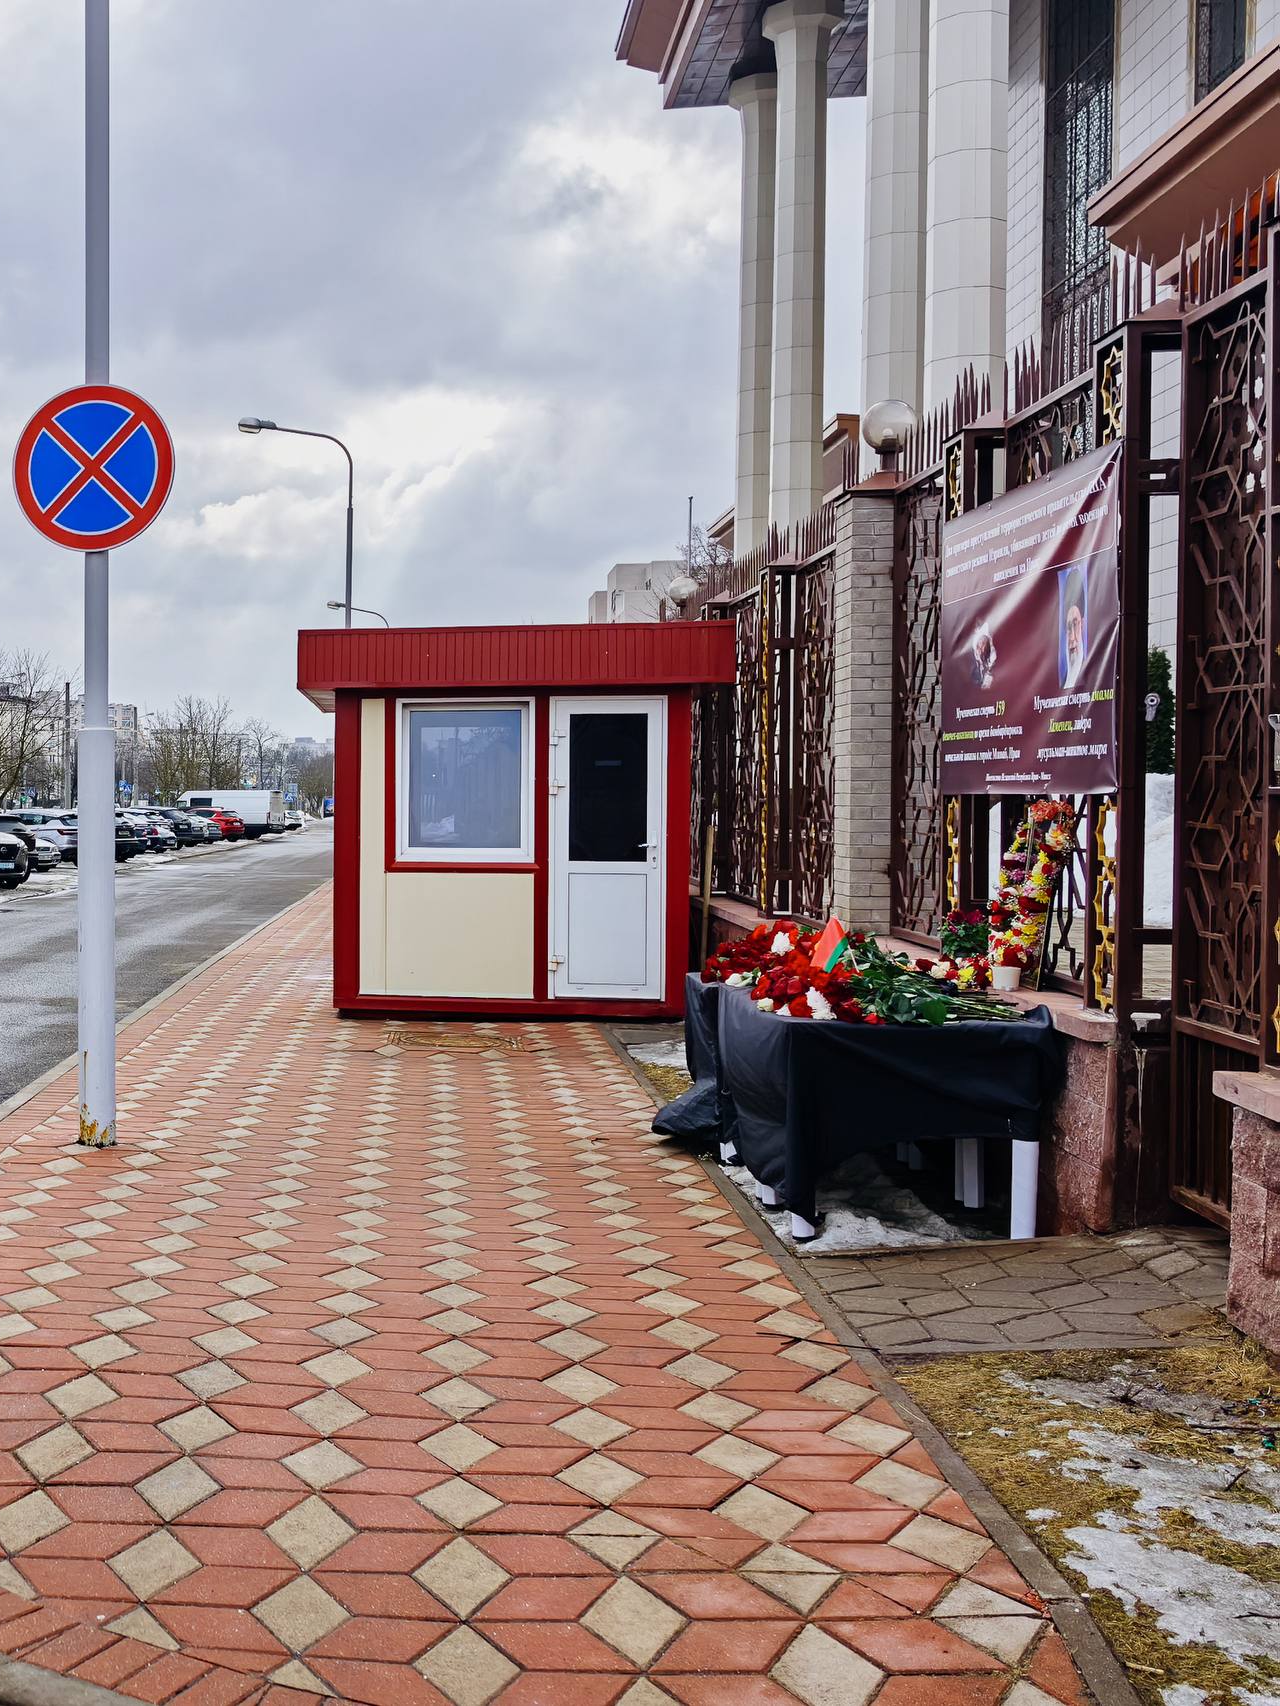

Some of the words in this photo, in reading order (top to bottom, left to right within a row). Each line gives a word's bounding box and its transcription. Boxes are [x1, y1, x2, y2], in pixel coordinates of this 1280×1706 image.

[996, 700, 1006, 716] 159
[1034, 694, 1068, 713] Мученическая
[1069, 692, 1090, 708] смерть
[1091, 689, 1114, 702] имама
[1073, 715, 1092, 733] лидера
[1037, 746, 1088, 762] мусульман-шиитов
[1089, 744, 1108, 760] мира
